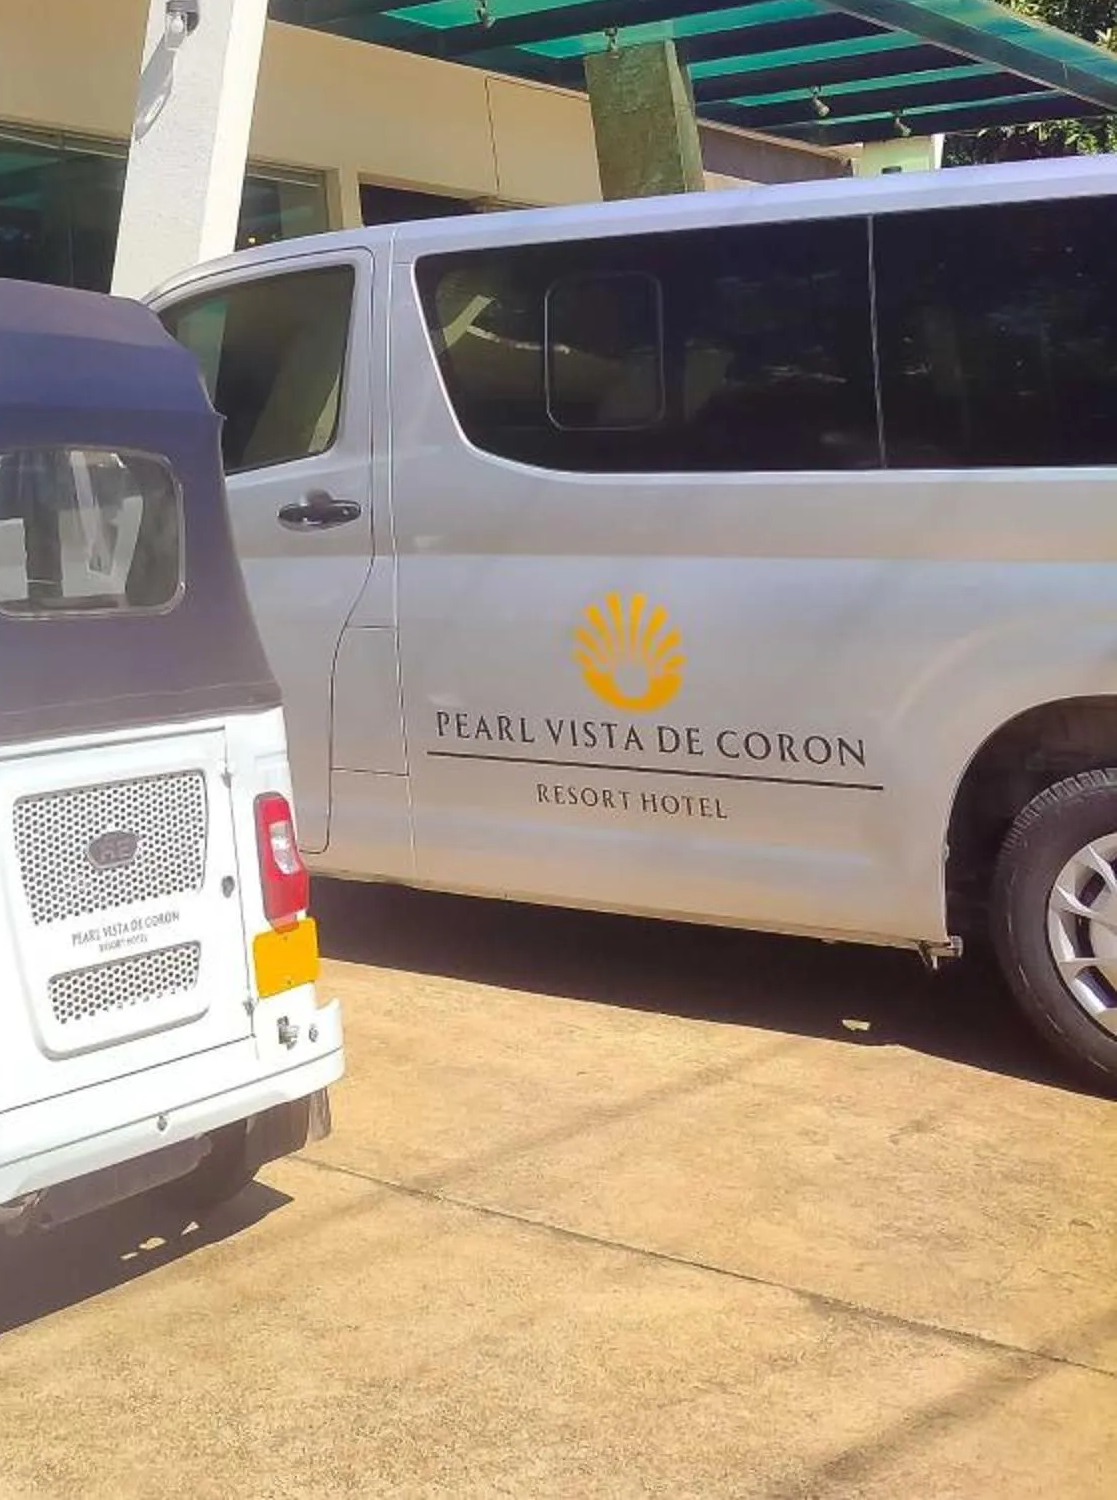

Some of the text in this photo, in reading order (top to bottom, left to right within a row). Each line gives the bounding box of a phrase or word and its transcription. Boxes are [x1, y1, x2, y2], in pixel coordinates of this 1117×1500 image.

[435, 710, 867, 768] PEARL VISTA DE CORON
[536, 783, 728, 820] RESORT HOTEL
[102, 922, 129, 938] VISTA
[144, 910, 180, 929] CORON
